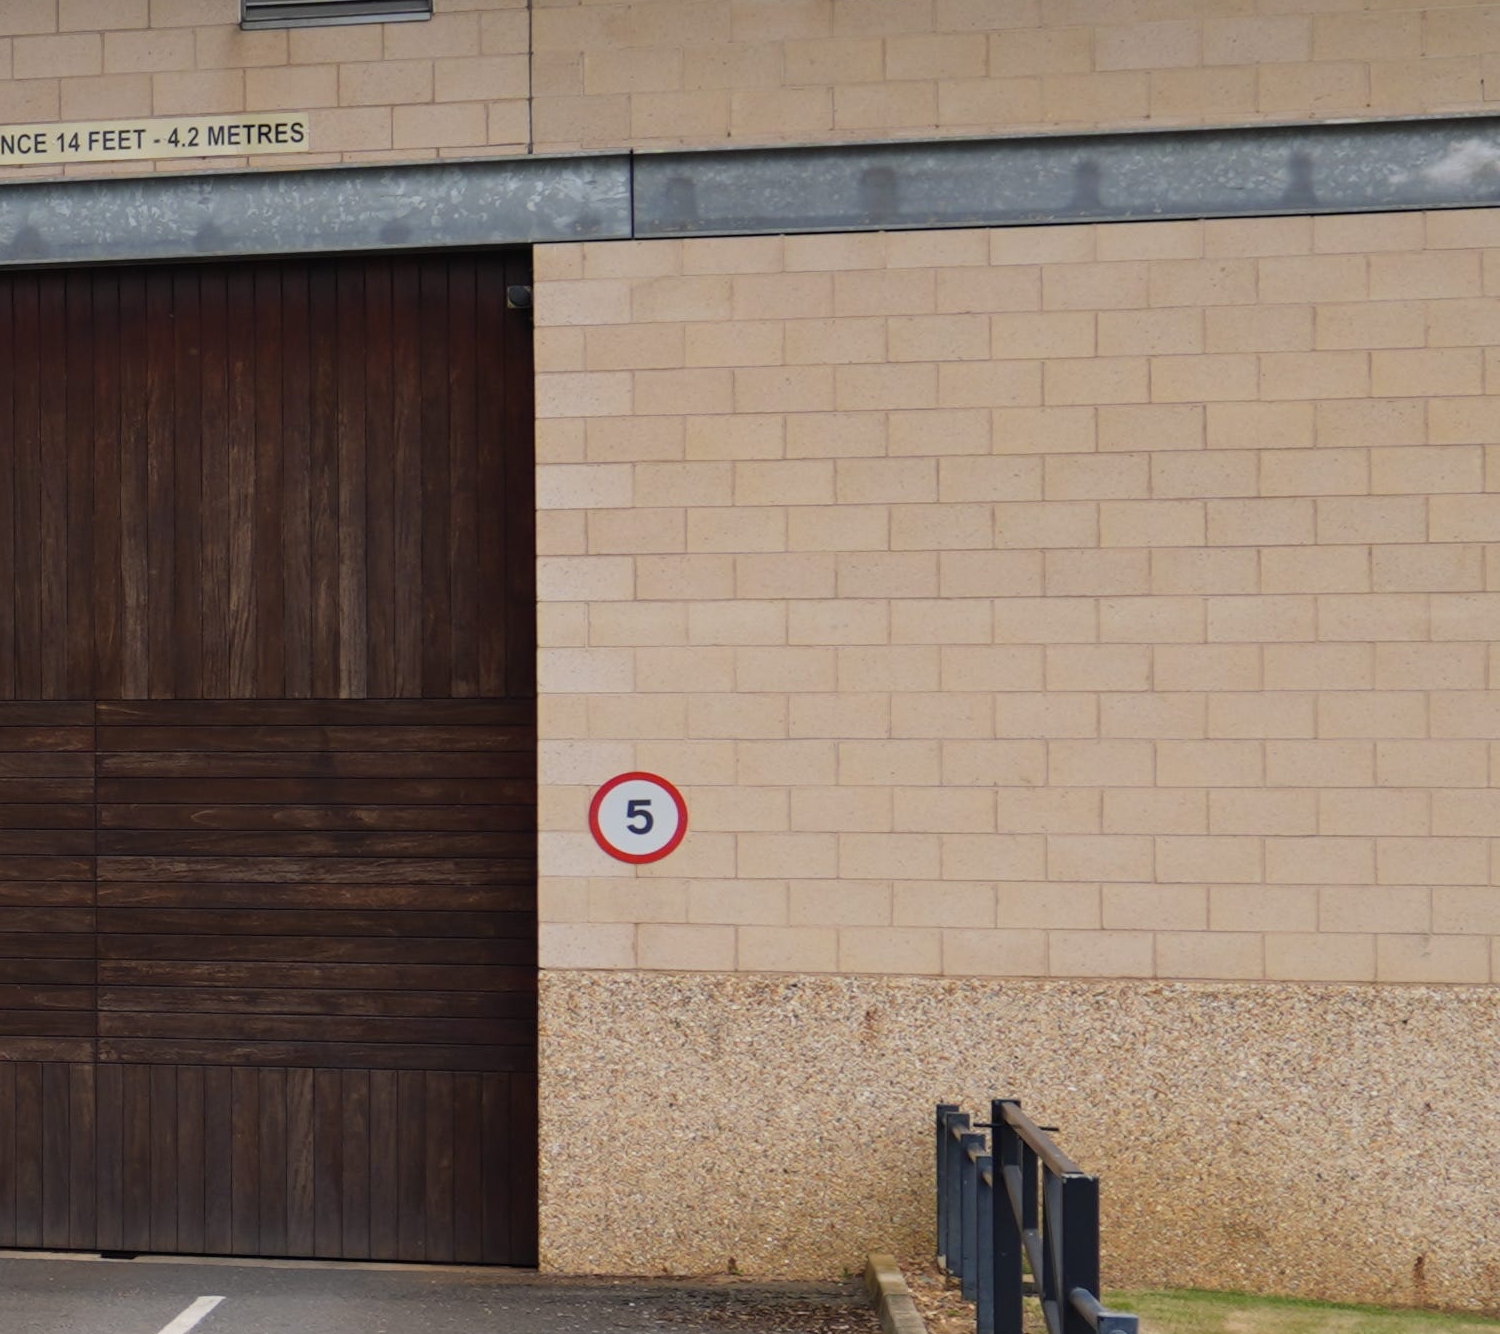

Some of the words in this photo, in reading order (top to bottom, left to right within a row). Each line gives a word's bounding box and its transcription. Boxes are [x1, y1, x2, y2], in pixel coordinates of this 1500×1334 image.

[56, 132, 80, 153] 14
[88, 128, 146, 151] FEET
[167, 127, 200, 148] 4.2
[207, 122, 305, 146] METRES
[626, 799, 654, 835] 5
